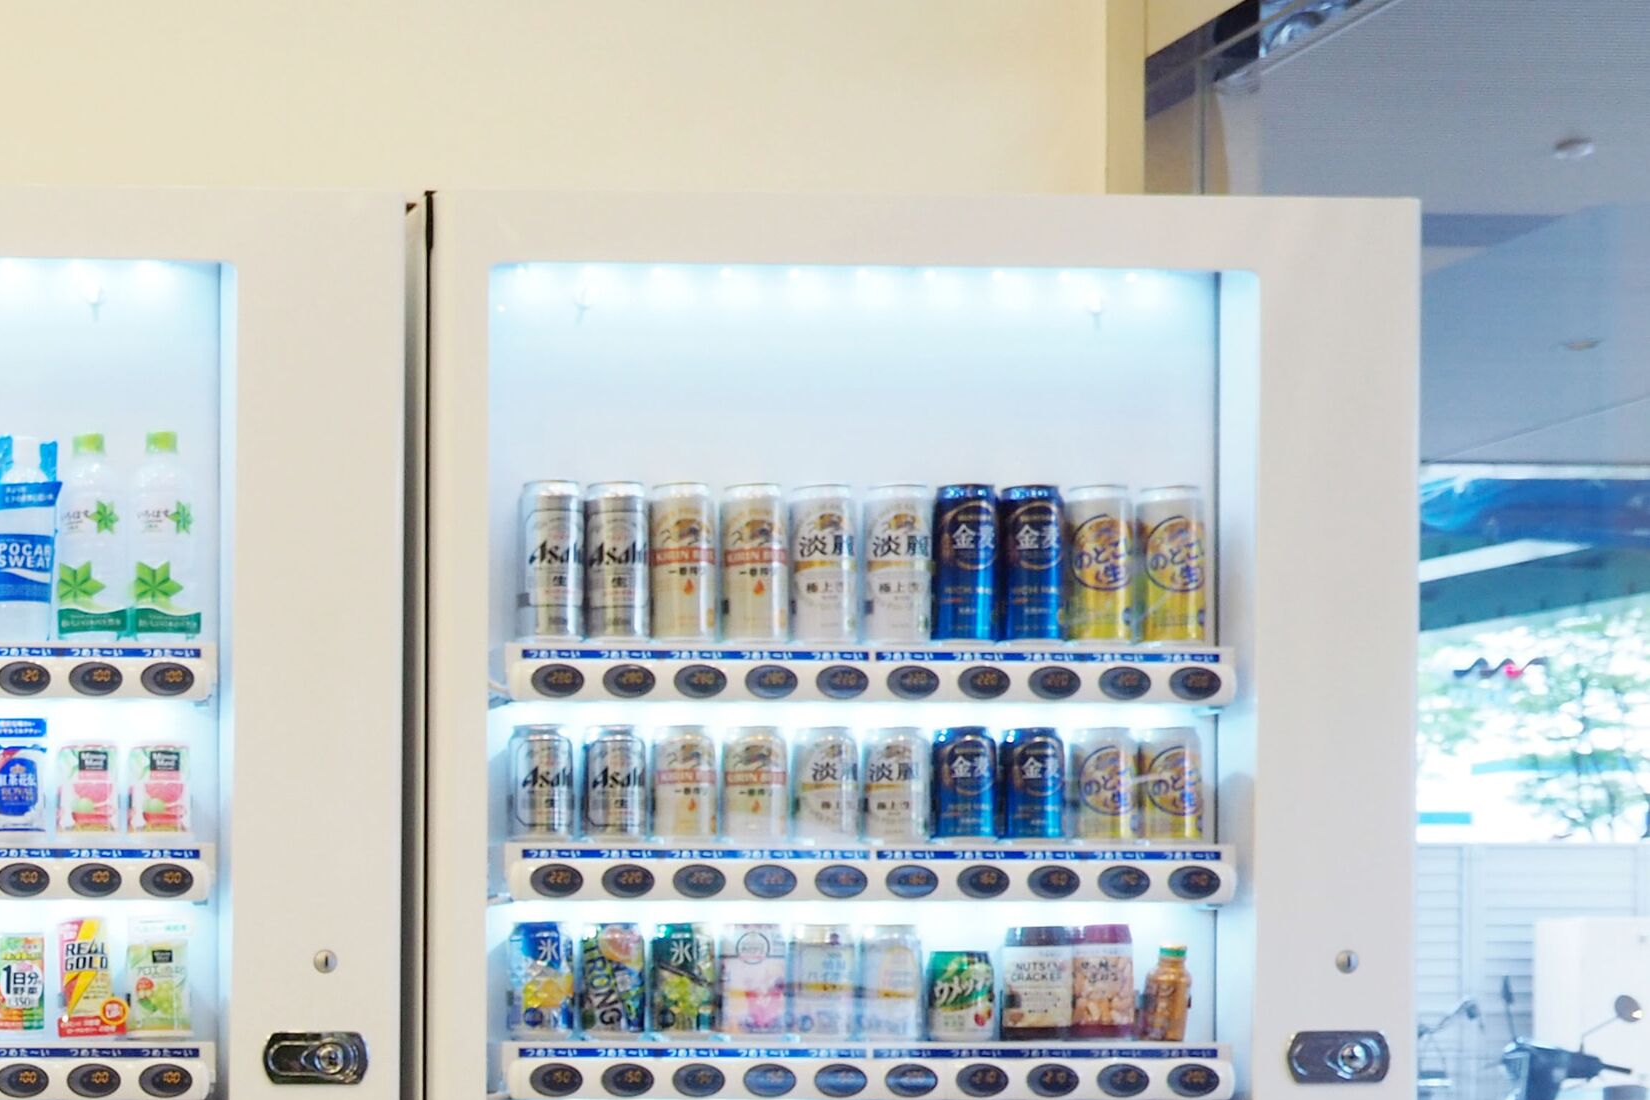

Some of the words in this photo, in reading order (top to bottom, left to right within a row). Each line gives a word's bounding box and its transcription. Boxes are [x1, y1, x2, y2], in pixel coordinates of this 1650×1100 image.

[951, 523, 996, 551] 金麦
[1015, 523, 1060, 551] 金麦
[951, 757, 991, 779] 金麦
[1021, 757, 1060, 780] 金麦
[64, 941, 108, 957] REAL
[63, 956, 109, 972] GOLD
